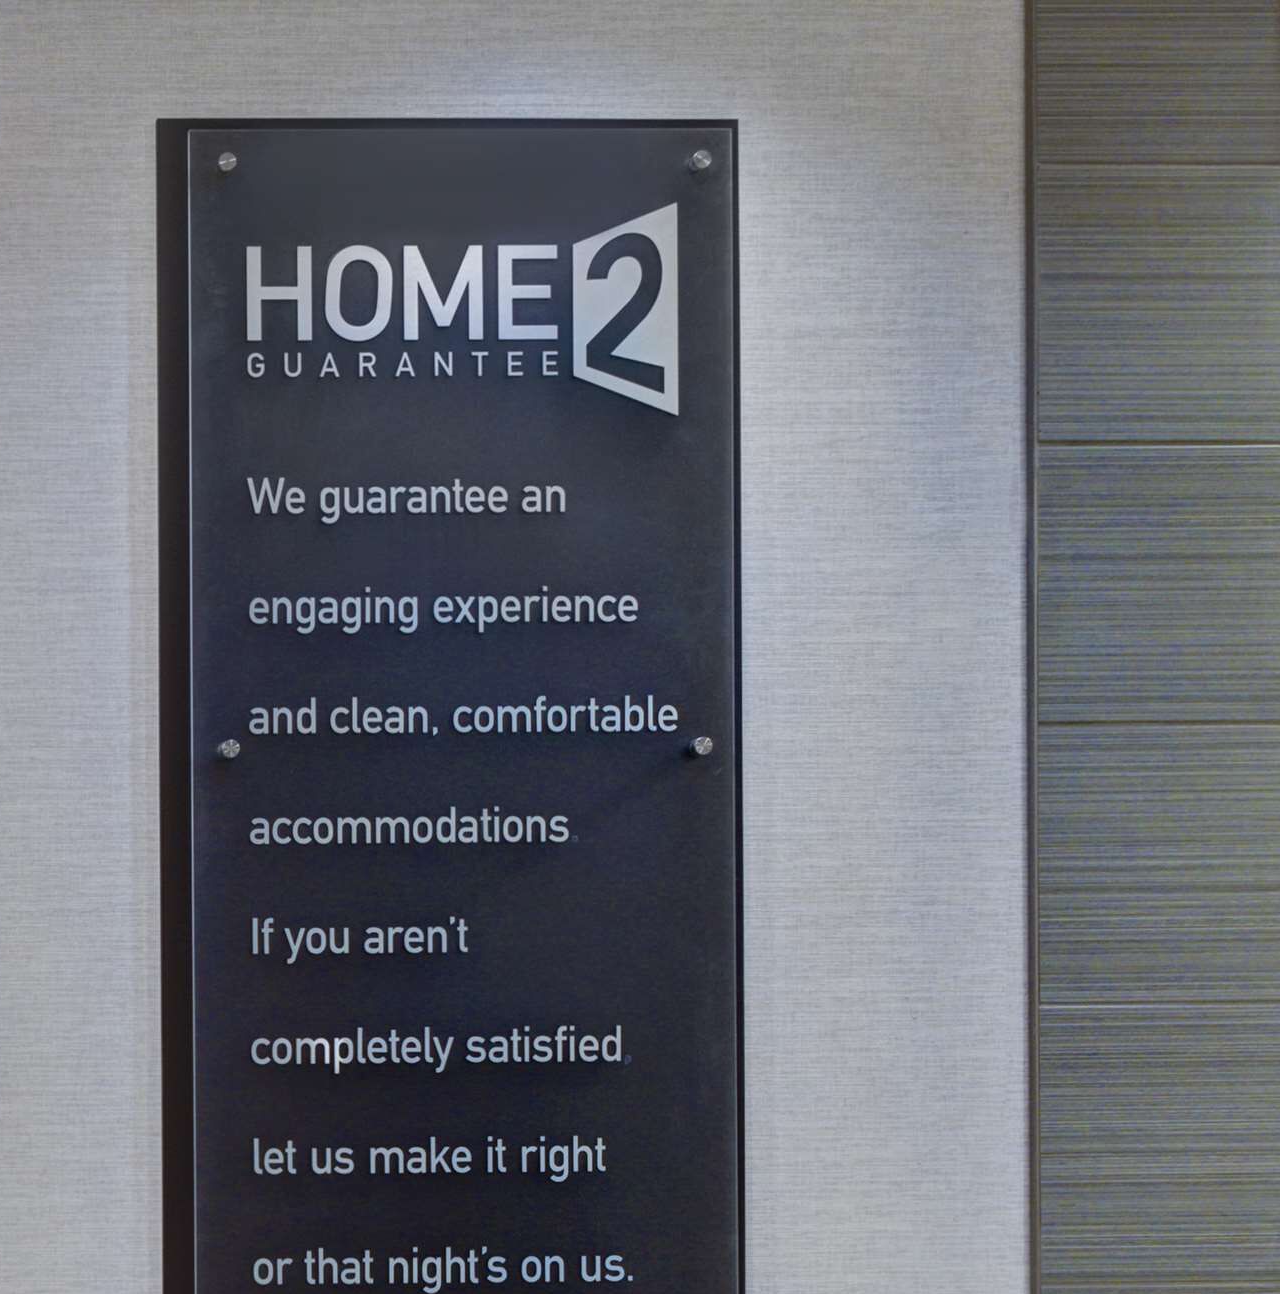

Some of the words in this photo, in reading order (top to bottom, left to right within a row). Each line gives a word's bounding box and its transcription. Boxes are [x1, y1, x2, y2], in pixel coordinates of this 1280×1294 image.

[246, 351, 559, 378] GUARANTEE
[247, 477, 306, 515] We
[319, 478, 509, 524] guarantee
[521, 485, 567, 513] an
[248, 586, 419, 634] engaging
[433, 586, 639, 633] experience
[248, 697, 317, 735] and
[329, 697, 439, 737] clean,
[452, 695, 679, 733] comfortable
[252, 917, 274, 955] If
[284, 927, 350, 965] you
[364, 917, 469, 954] aren't
[251, 1026, 455, 1075] completely
[253, 1138, 297, 1175] let
[311, 1147, 355, 1175] us
[369, 1137, 472, 1174] make
[487, 1136, 507, 1173] it
[521, 1136, 607, 1183] right
[253, 1257, 293, 1285] or
[303, 1247, 374, 1285] that
[388, 1246, 508, 1294] night's
[521, 1255, 565, 1283] on
[581, 1254, 634, 1283] us.
